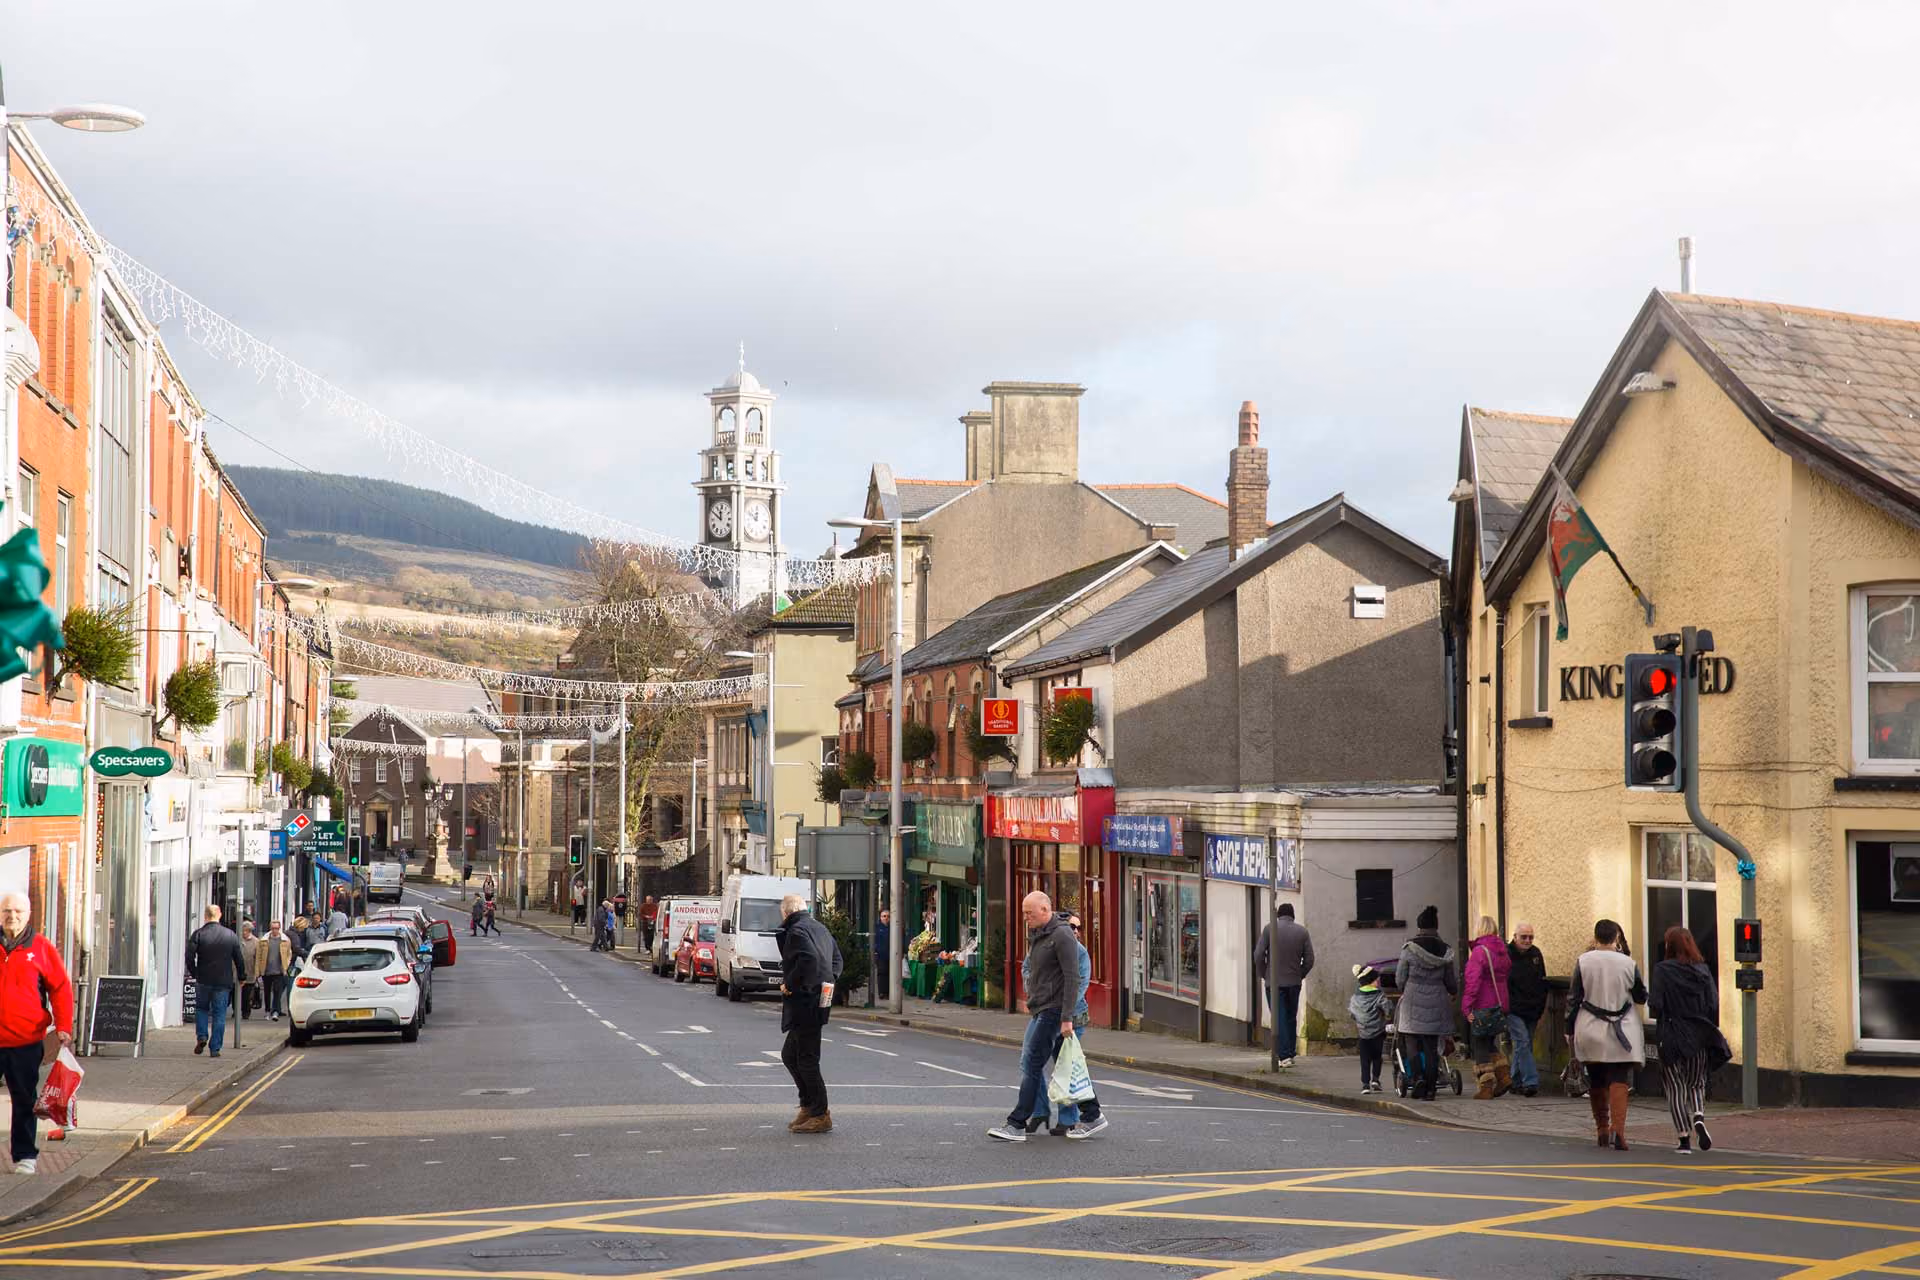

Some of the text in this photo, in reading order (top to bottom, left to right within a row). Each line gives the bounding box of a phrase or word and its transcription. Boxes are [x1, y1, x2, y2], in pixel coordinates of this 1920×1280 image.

[97, 754, 165, 768] Specsavers
[318, 832, 334, 840] LET
[1216, 840, 1284, 881] SHOE REPAIS
[674, 906, 705, 914] ANDREW
